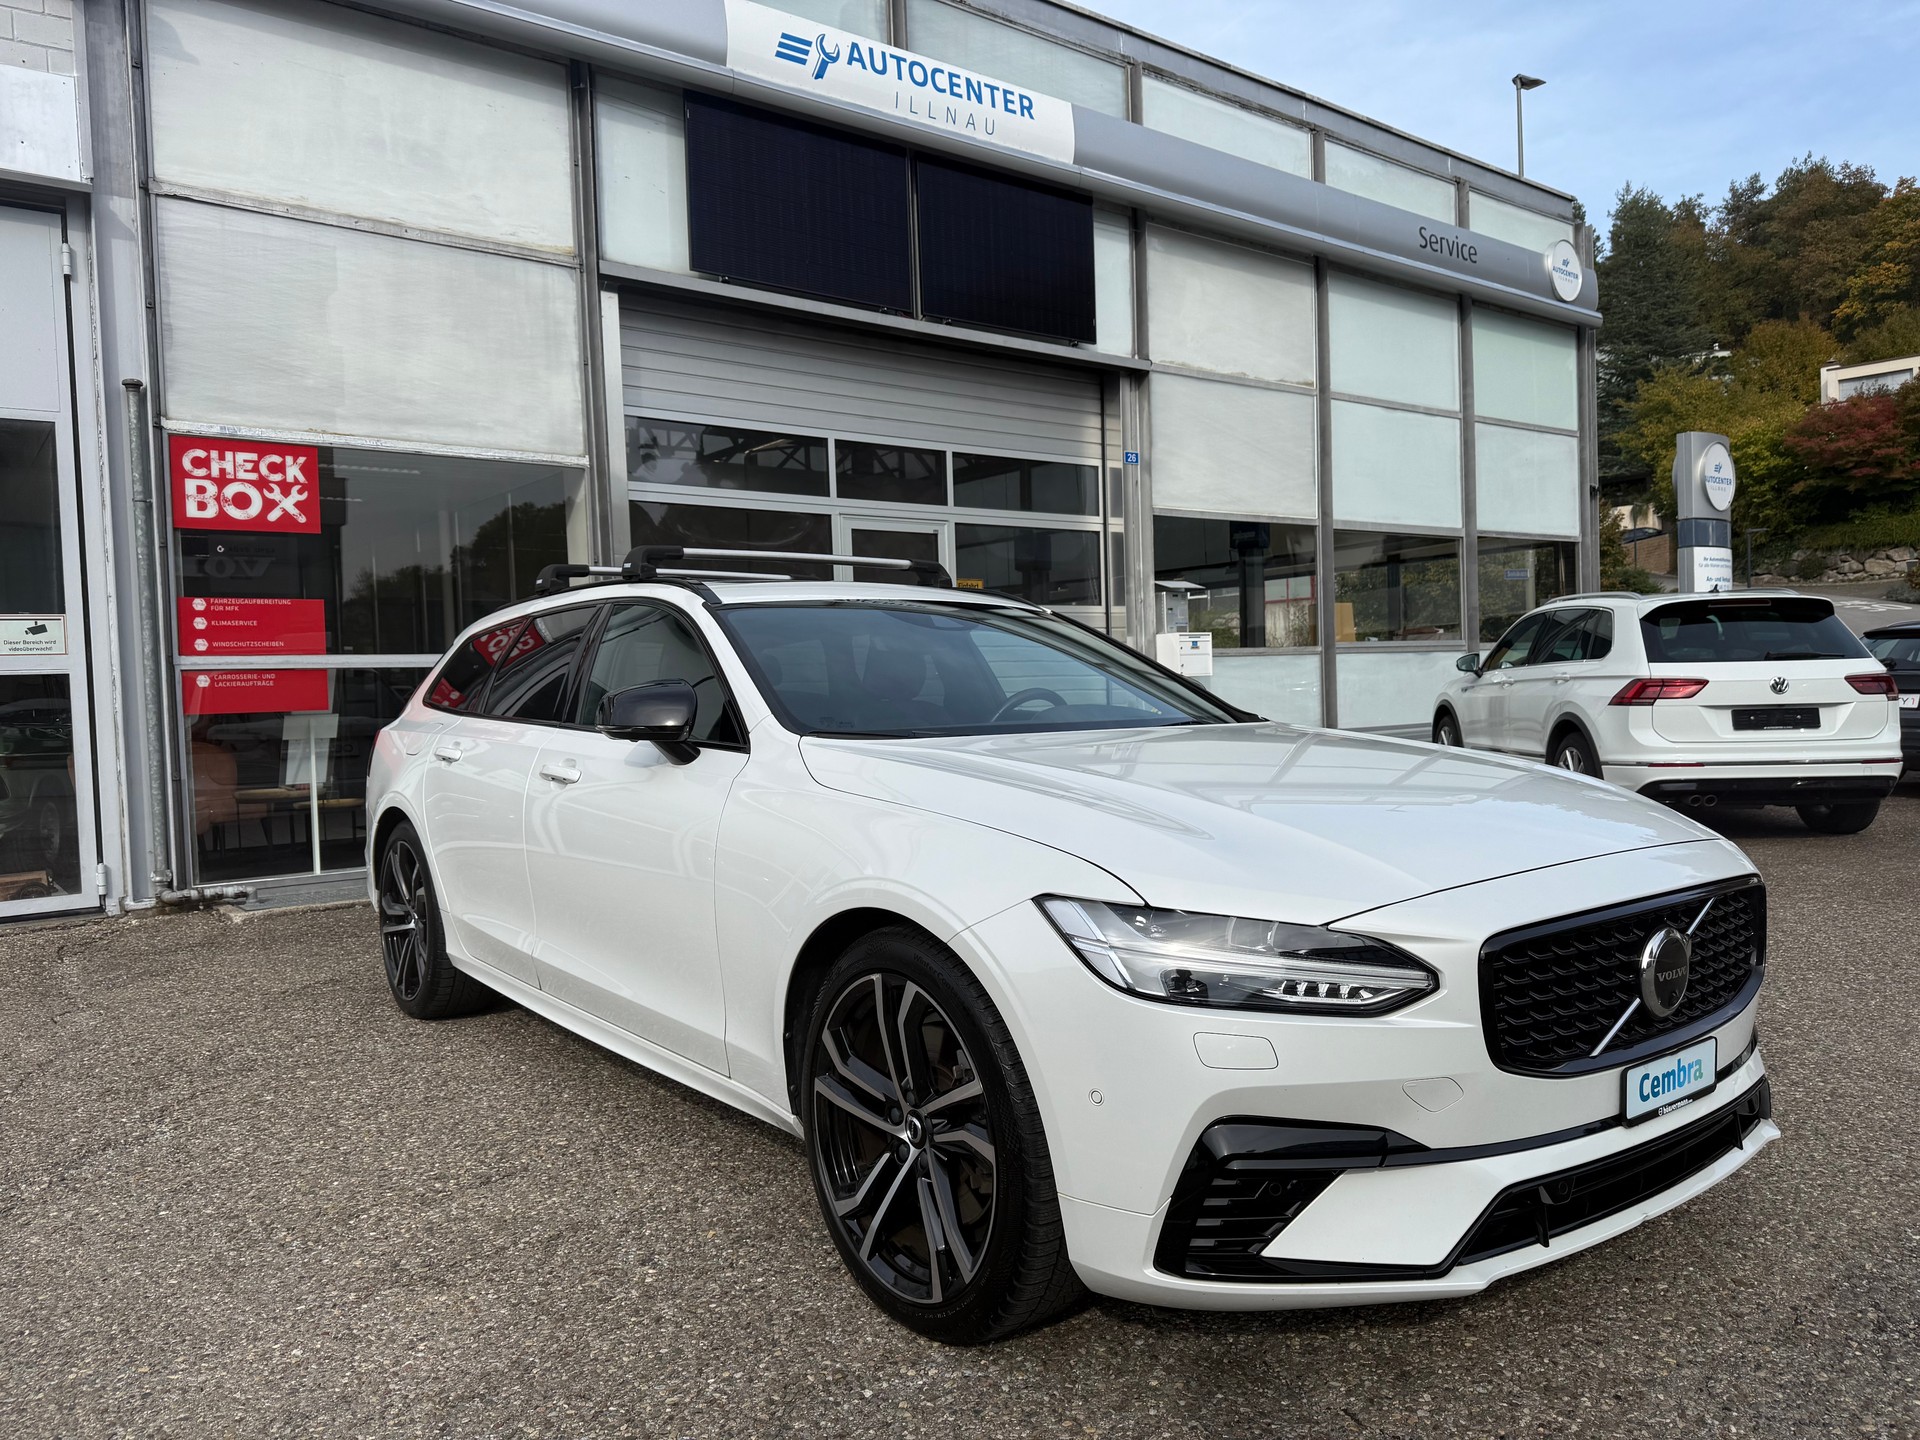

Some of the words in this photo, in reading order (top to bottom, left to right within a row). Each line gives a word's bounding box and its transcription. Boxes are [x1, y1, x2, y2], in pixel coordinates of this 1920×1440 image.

[846, 41, 1035, 120] AUTOCENTER
[894, 91, 996, 136] ILLNAU
[1418, 226, 1478, 264] Service
[1552, 265, 1579, 280] AUTOCENTER
[182, 448, 308, 484] CHECK
[1127, 453, 1137, 462] 26
[184, 478, 309, 524] BOX
[1656, 965, 1688, 982] VOLVO
[1638, 1057, 1704, 1103] Cembra
